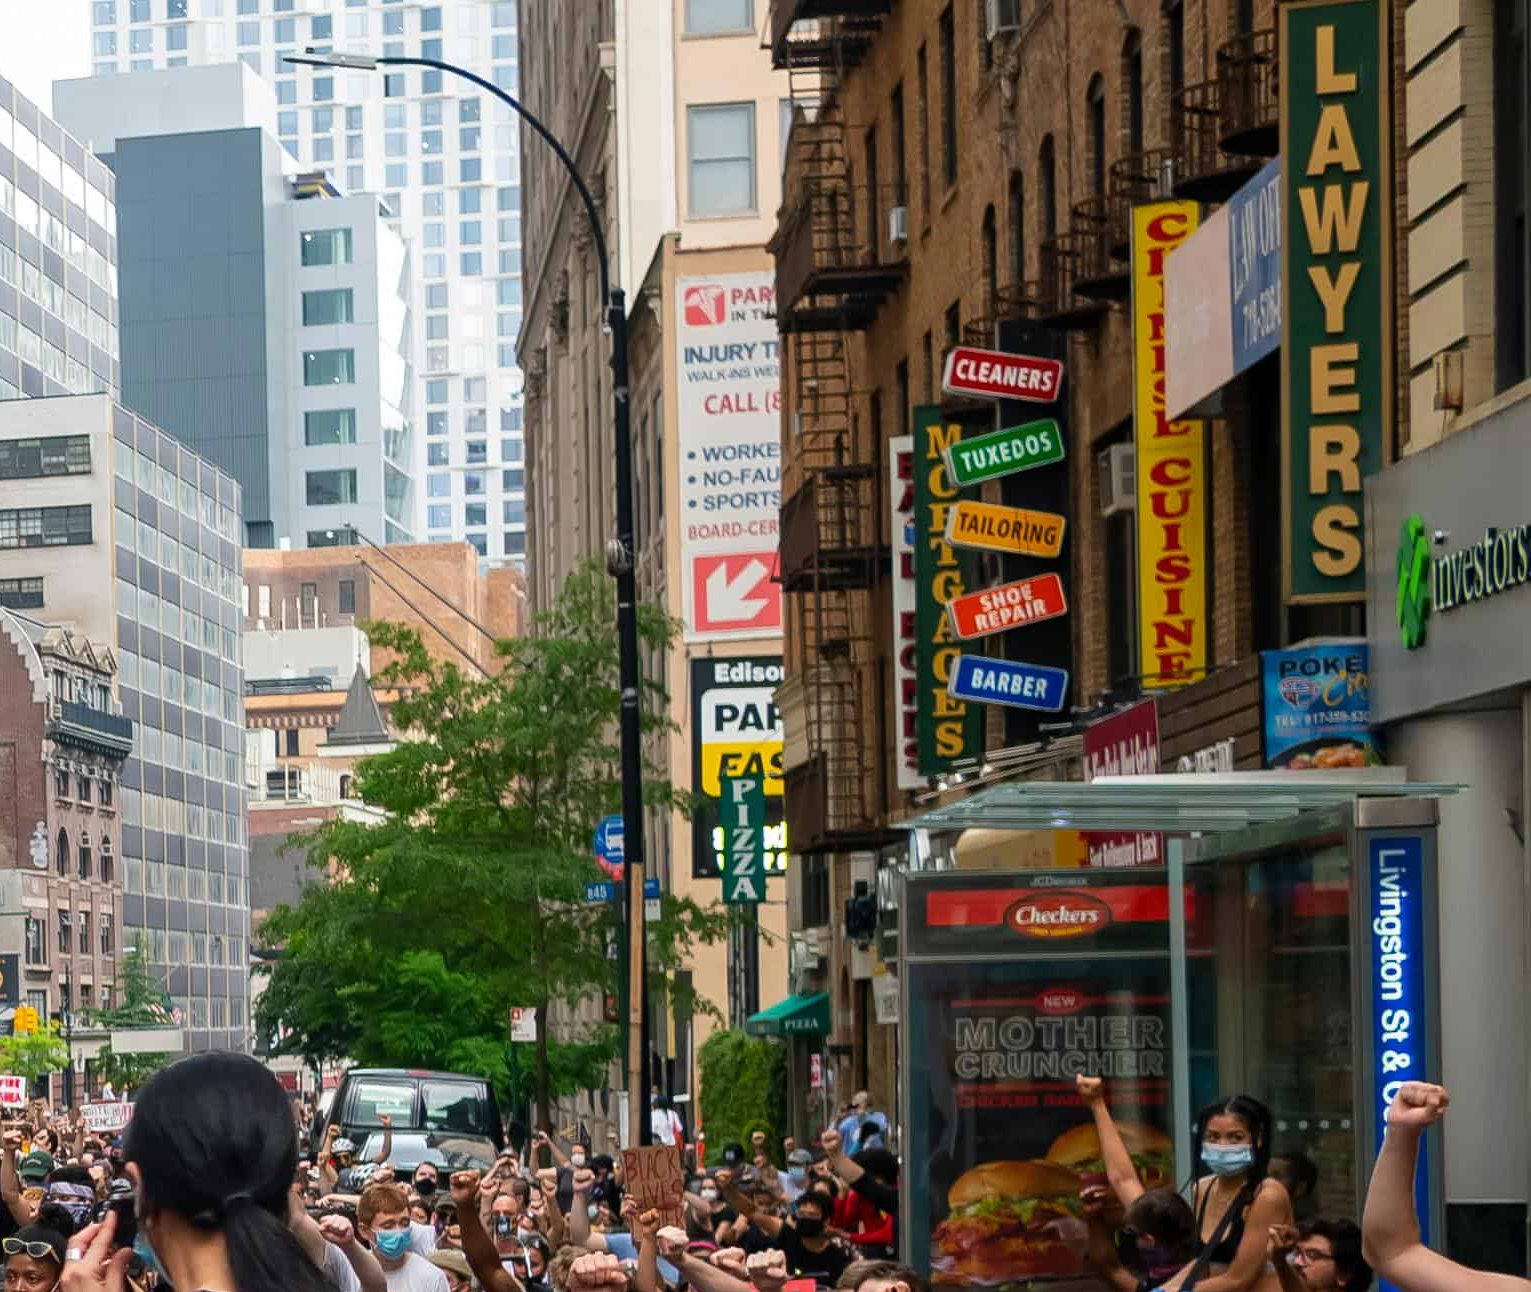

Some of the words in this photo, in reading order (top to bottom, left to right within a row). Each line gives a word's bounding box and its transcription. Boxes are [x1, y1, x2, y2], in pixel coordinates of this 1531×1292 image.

[1298, 24, 1370, 577] LAWYERS
[684, 343, 757, 364] INJURY
[955, 358, 1053, 392] CLEANERS
[704, 391, 760, 415] CALL
[960, 431, 1052, 473] TUXEDOS
[959, 512, 1057, 546] TAILORING
[1150, 457, 1195, 683] CUISINE
[980, 584, 1033, 612] SHOE
[974, 599, 1047, 631] REPAIR
[1280, 655, 1363, 678] POKE
[971, 667, 1048, 700] BARBER
[730, 779, 758, 901] PIZZA
[1015, 904, 1099, 925] Checkers
[1373, 849, 1409, 1001] Livingston
[1043, 996, 1076, 1009] NEW
[955, 1015, 1164, 1050] MOTHER
[1380, 1009, 1411, 1043] St
[954, 1051, 1164, 1079] CRUNCHER
[1381, 1050, 1411, 1073] &
